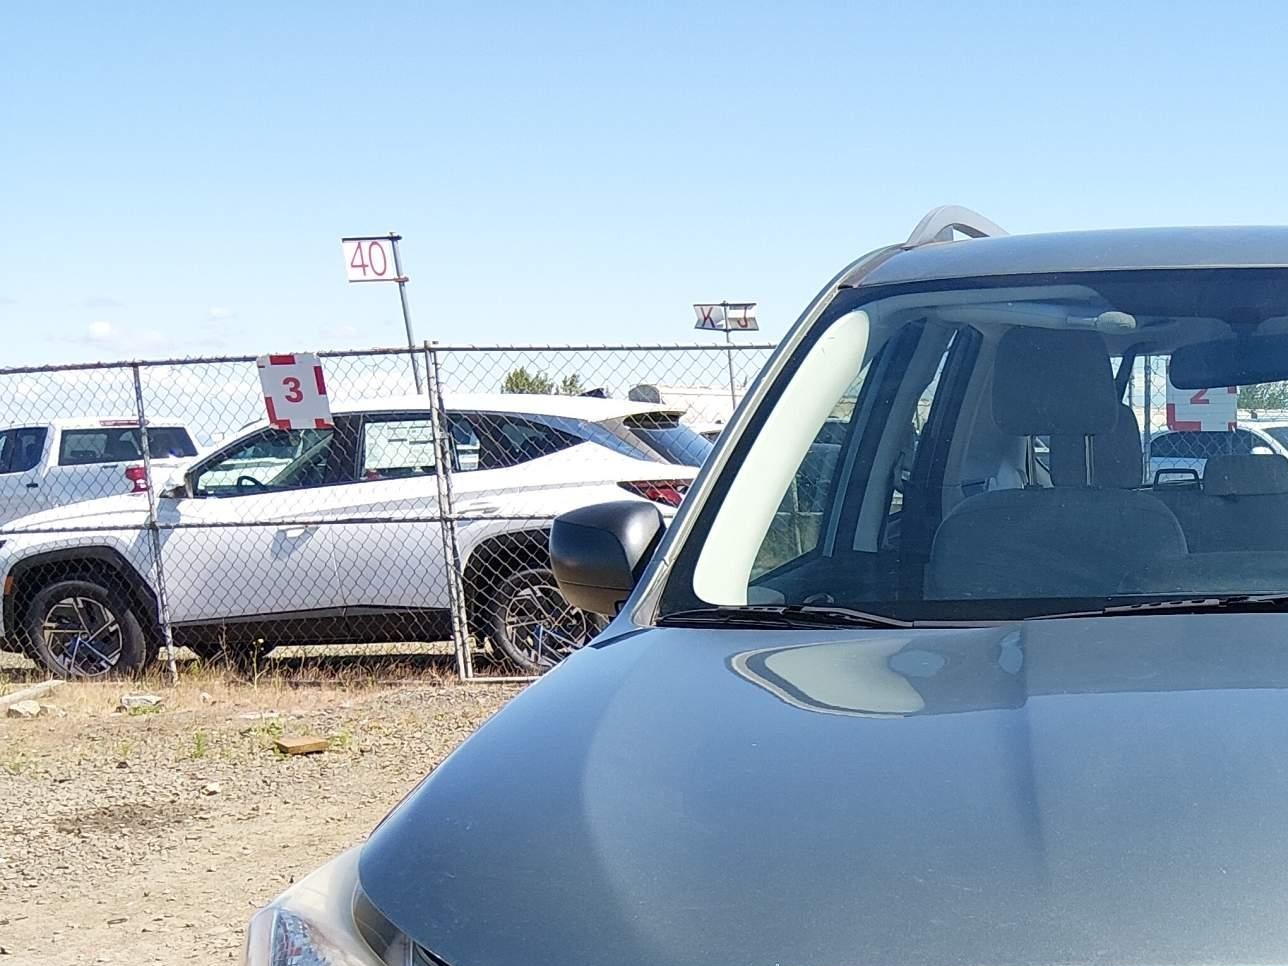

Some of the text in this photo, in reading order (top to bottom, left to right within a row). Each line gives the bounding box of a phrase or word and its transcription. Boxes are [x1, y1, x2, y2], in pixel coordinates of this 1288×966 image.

[350, 241, 387, 277] 40
[700, 306, 716, 329] K
[736, 304, 748, 328] J
[282, 377, 304, 403] 3
